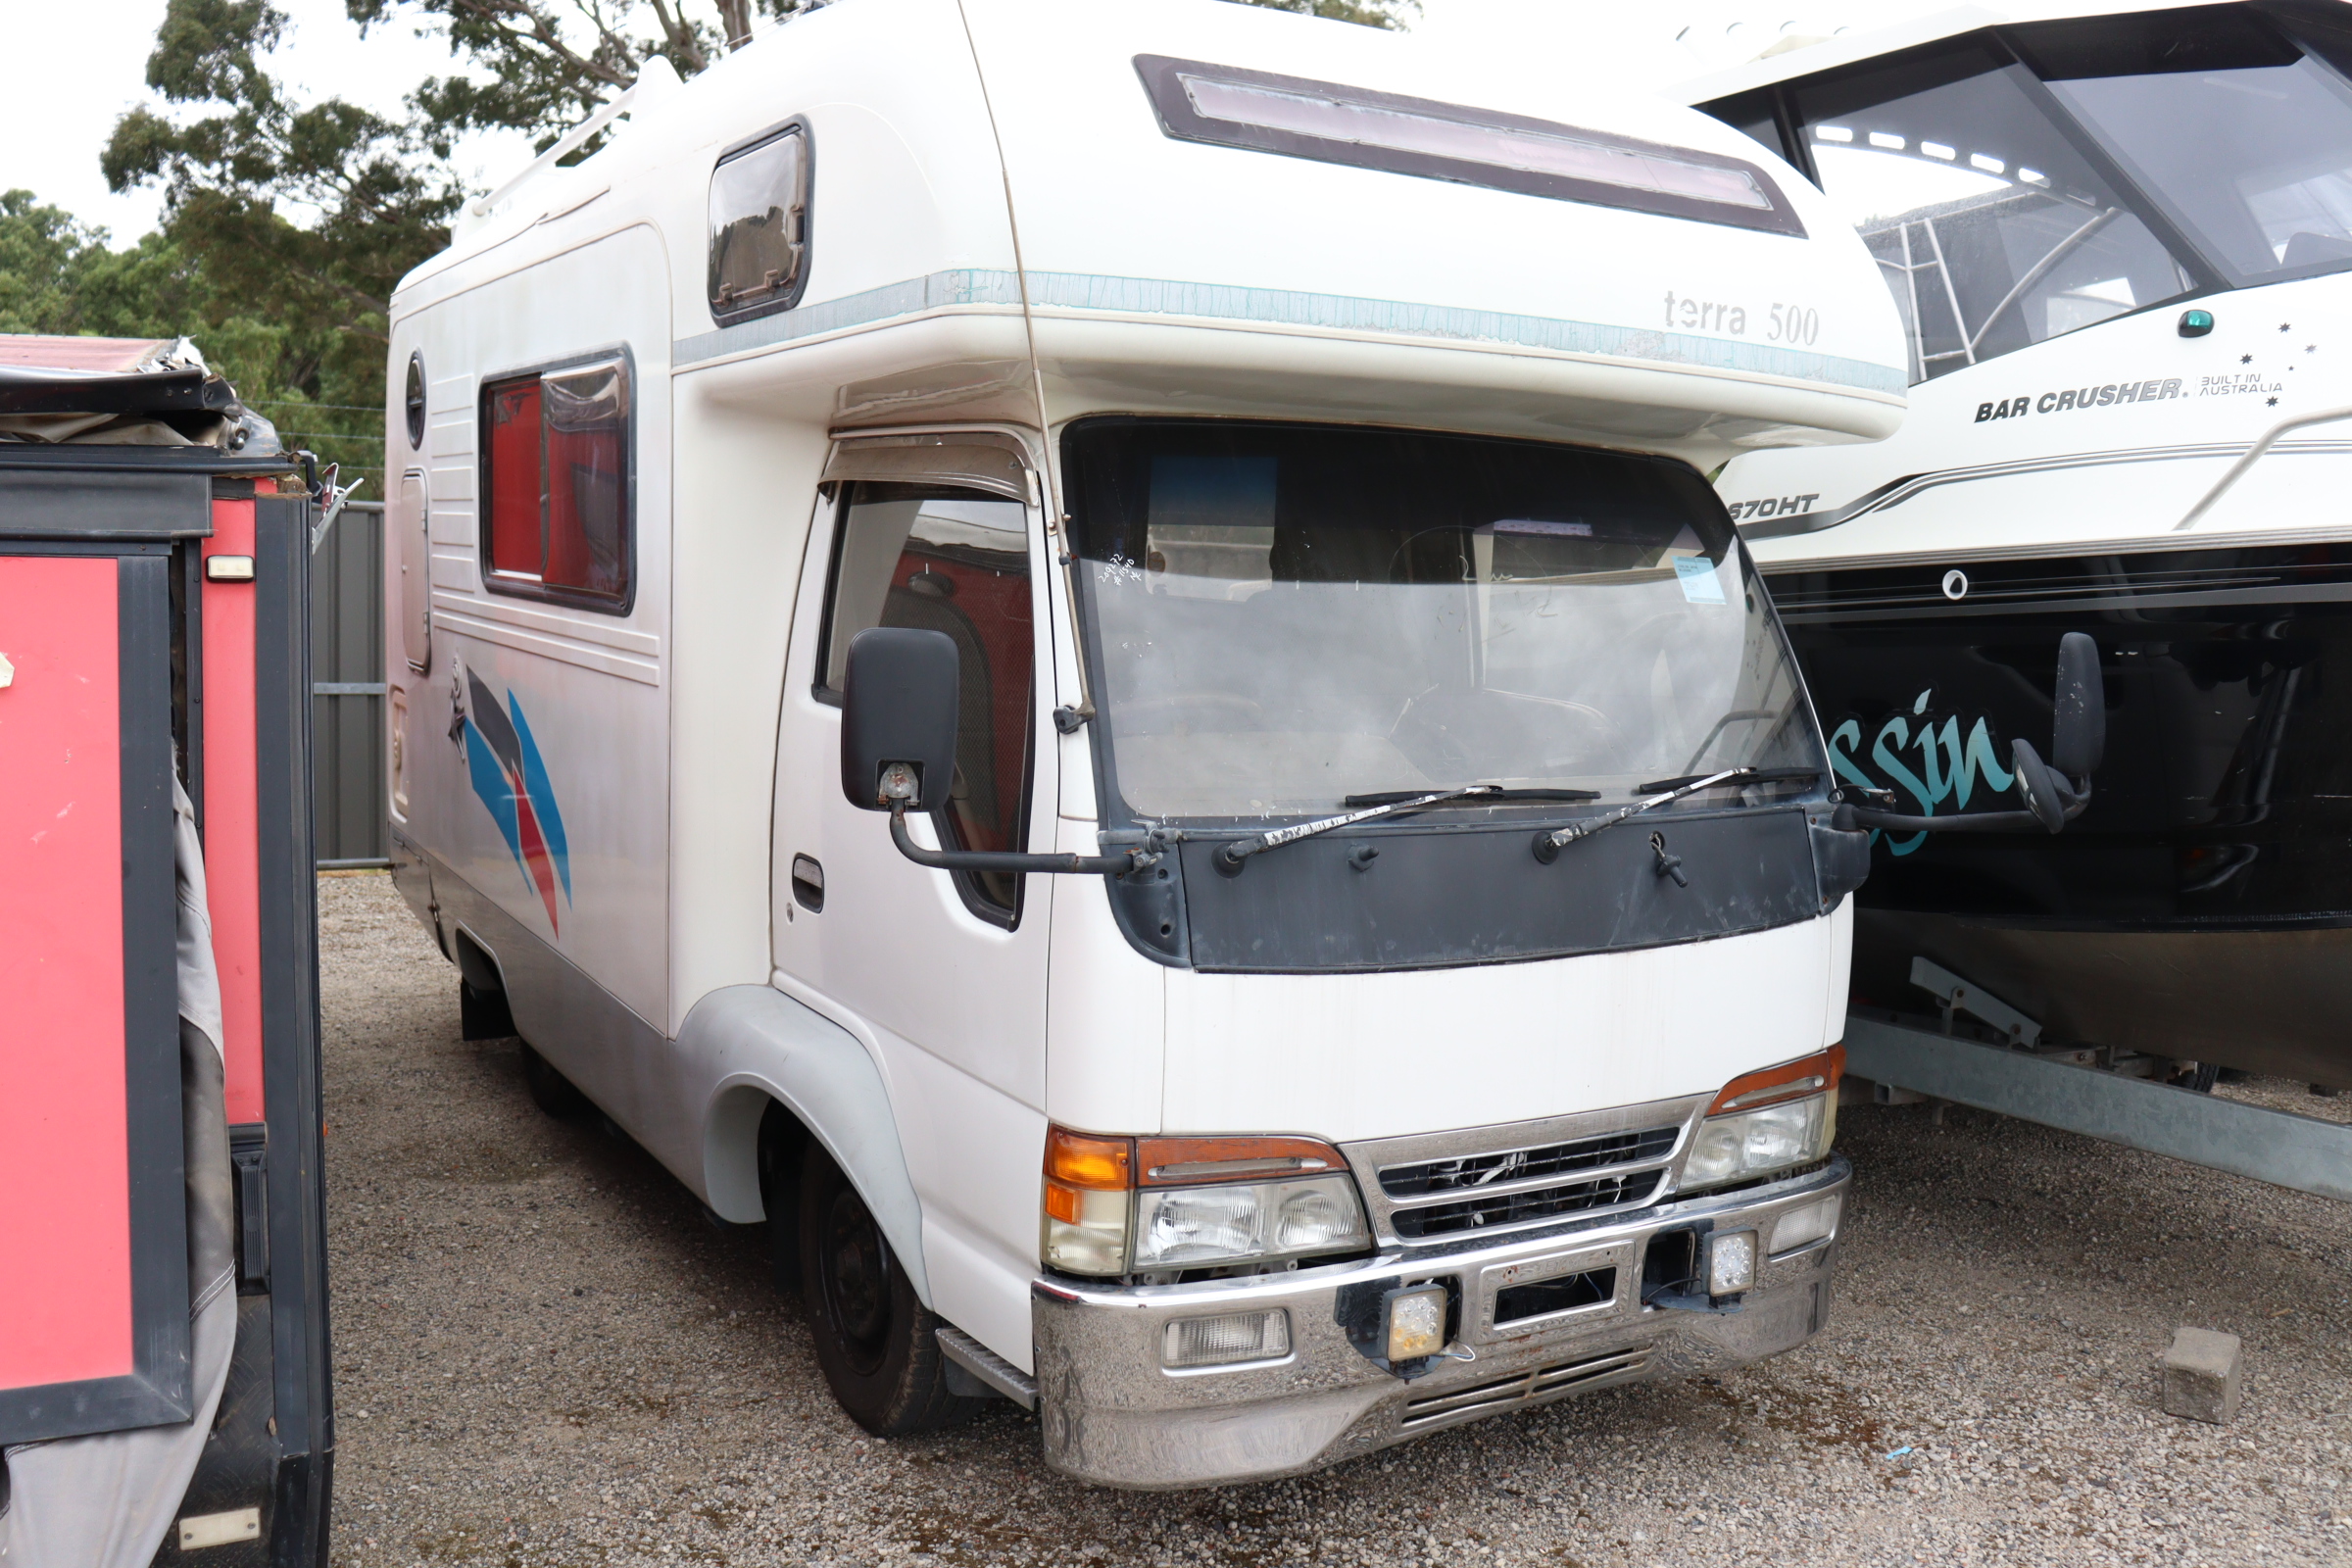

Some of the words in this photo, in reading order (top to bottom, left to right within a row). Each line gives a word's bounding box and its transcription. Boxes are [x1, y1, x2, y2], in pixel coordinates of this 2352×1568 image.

[1664, 290, 1746, 335] terra
[1767, 302, 1819, 346] 500
[2198, 382, 2283, 397] AUSTRALIA
[2200, 373, 2242, 387] BUILT
[2244, 372, 2262, 384] IN
[1974, 396, 2031, 423] BAR
[1728, 493, 1820, 520] 670HT
